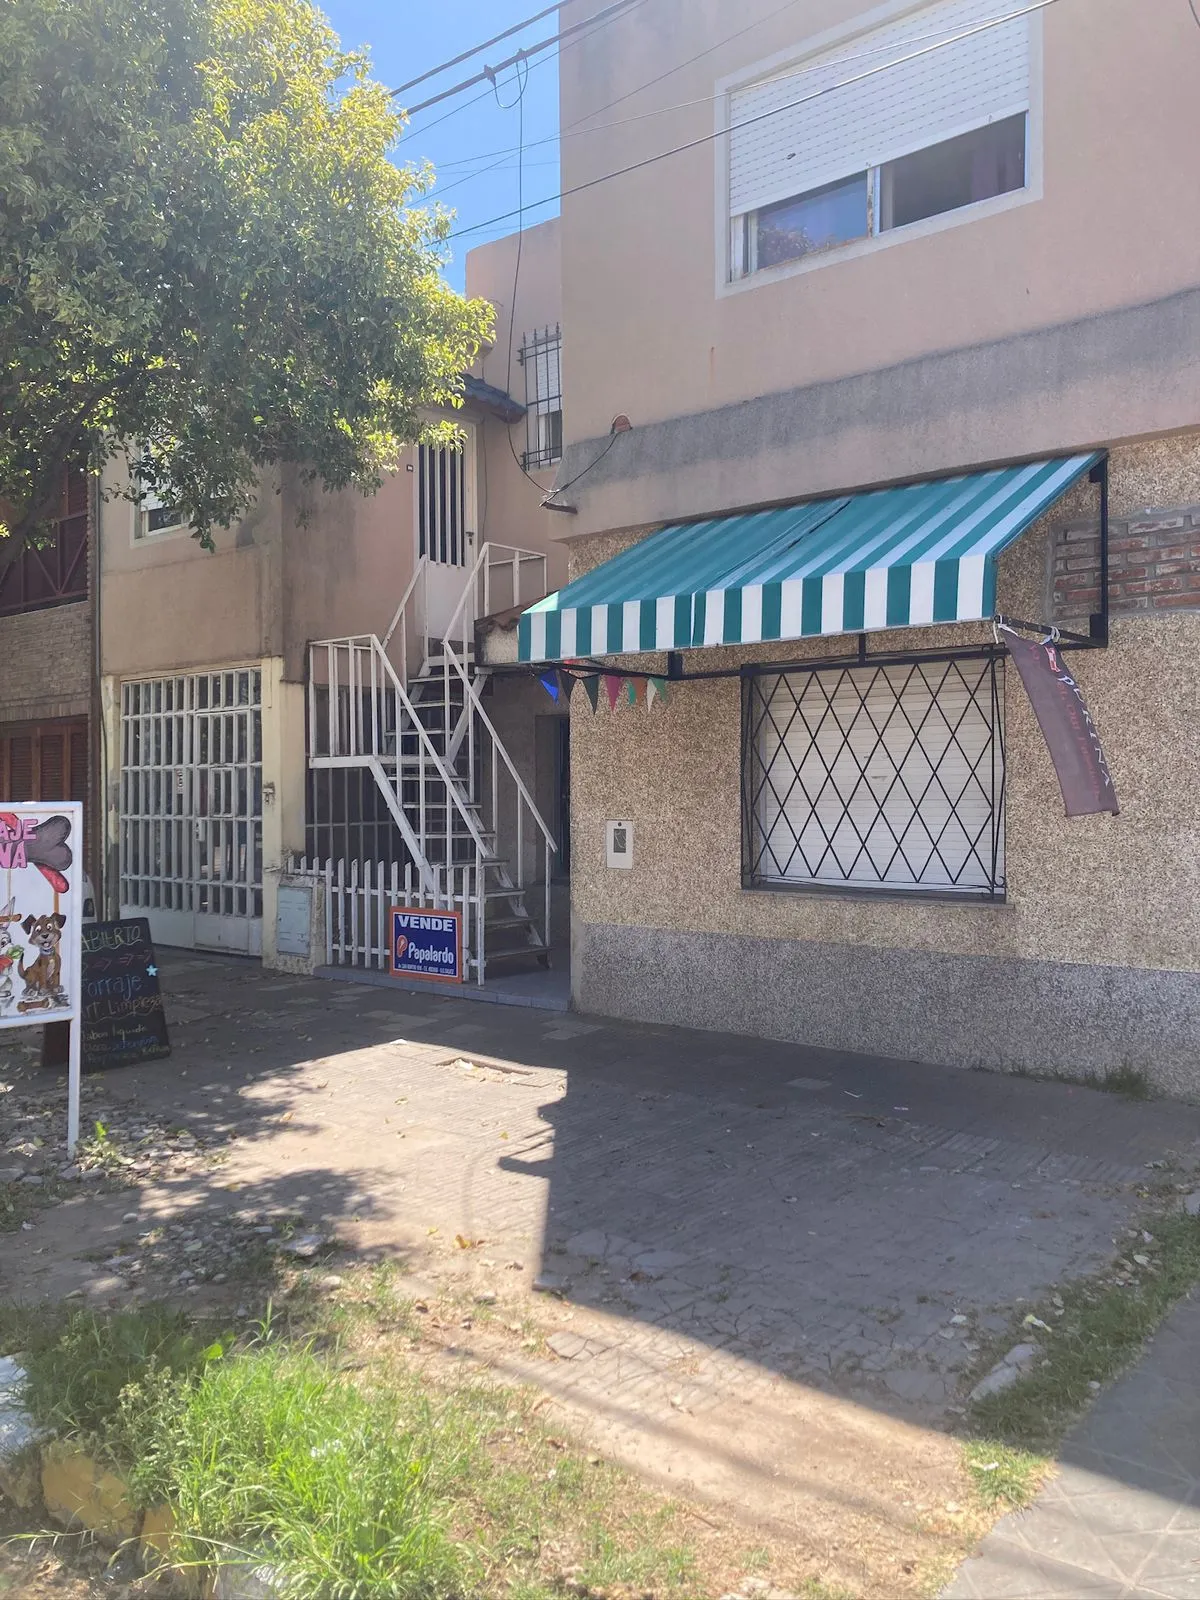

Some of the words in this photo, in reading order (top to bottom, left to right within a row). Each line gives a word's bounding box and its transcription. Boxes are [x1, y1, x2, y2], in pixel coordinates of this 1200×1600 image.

[1057, 674, 1110, 786] PURINA
[398, 915, 453, 932] VENDE
[408, 941, 454, 964] Papalardo
